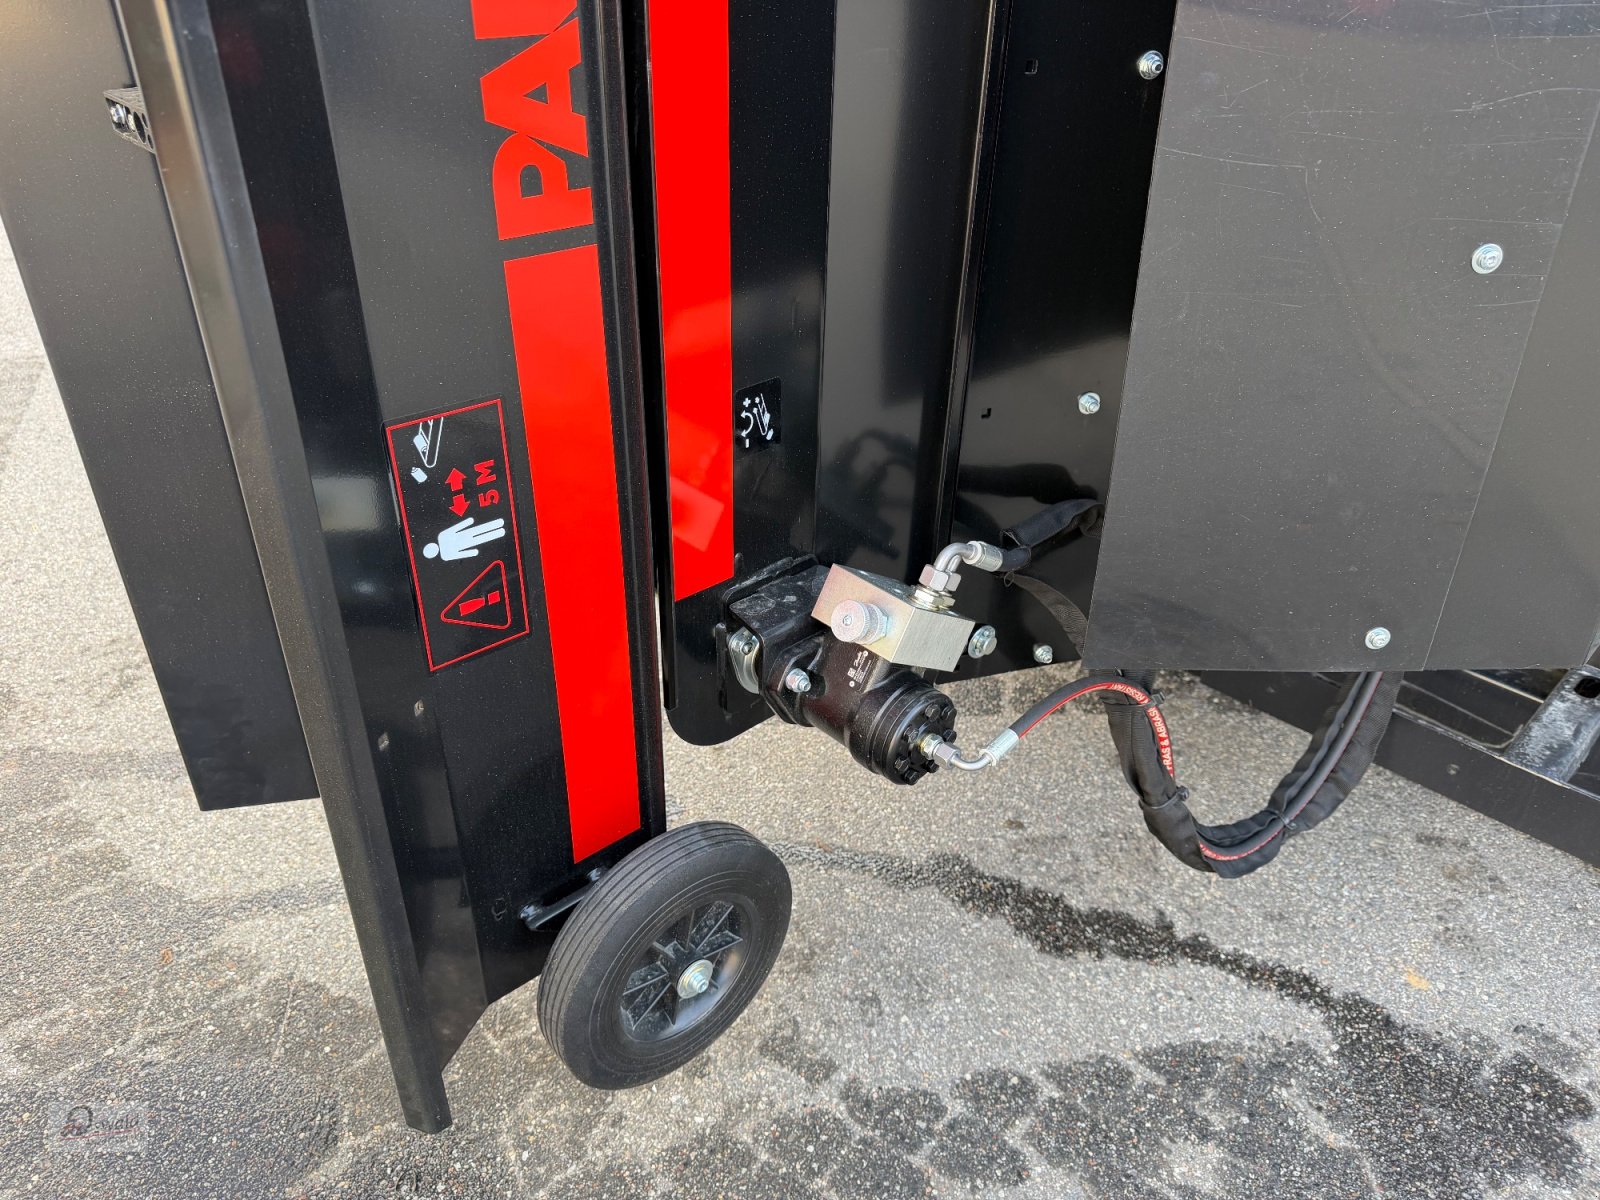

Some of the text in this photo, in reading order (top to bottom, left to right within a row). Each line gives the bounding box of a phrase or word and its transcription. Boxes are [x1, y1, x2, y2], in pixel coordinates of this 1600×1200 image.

[470, 0, 594, 241] PA
[474, 459, 500, 507] 5 M
